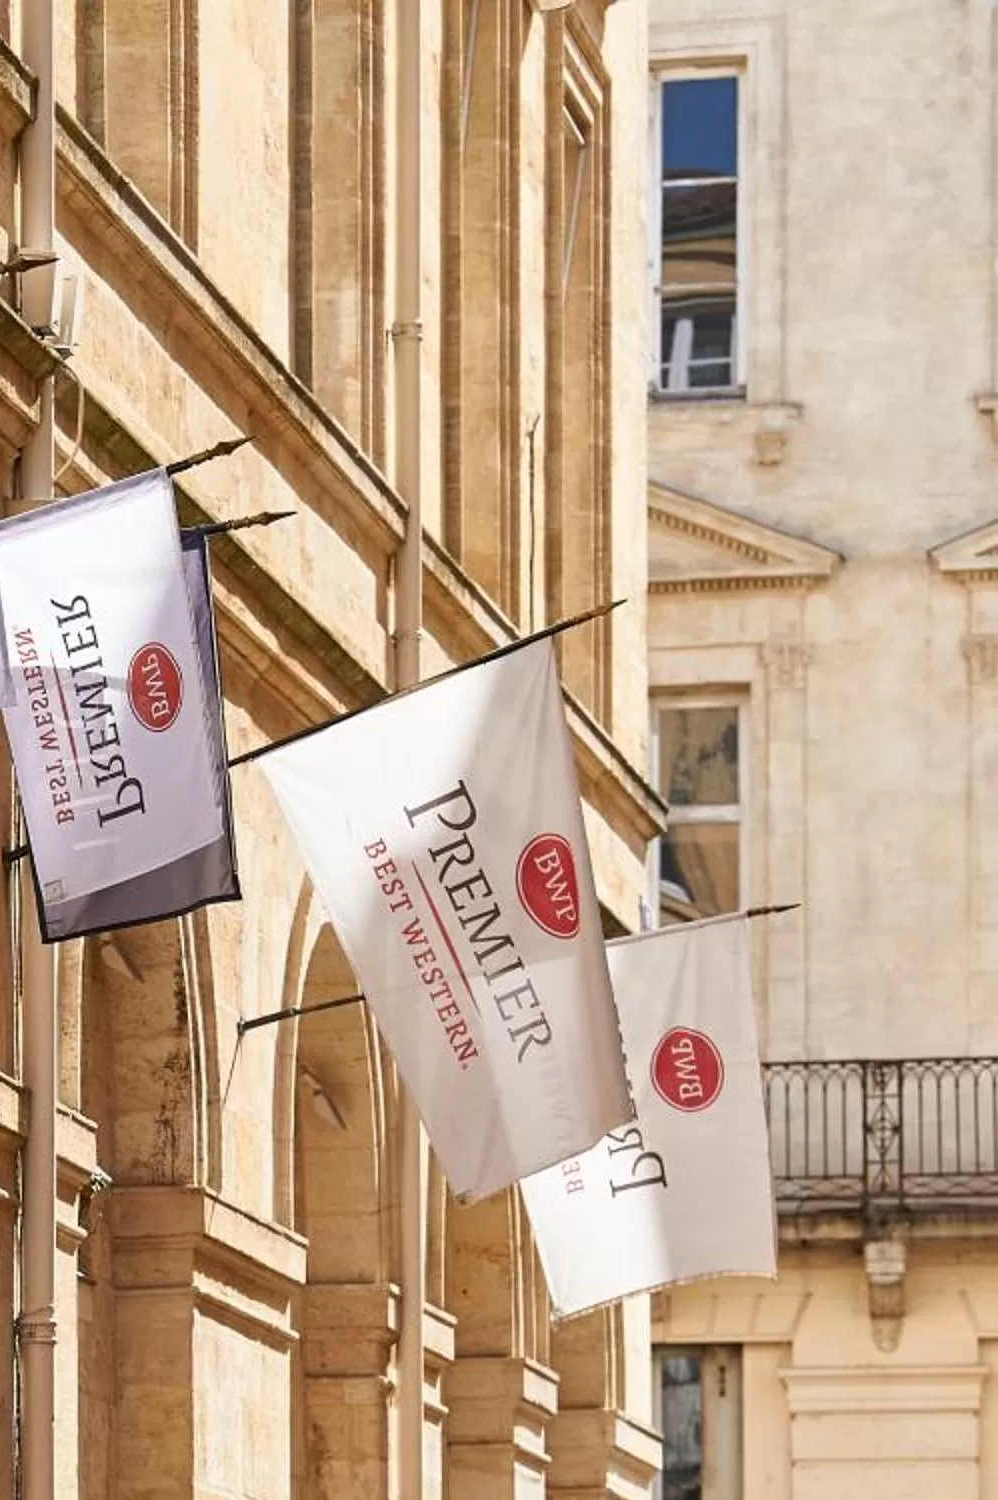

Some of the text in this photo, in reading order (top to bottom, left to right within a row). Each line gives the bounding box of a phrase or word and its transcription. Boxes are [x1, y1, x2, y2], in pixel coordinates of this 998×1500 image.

[364, 837, 414, 913] BEST
[534, 847, 576, 922] BWP
[403, 779, 552, 1063] PREMIER
